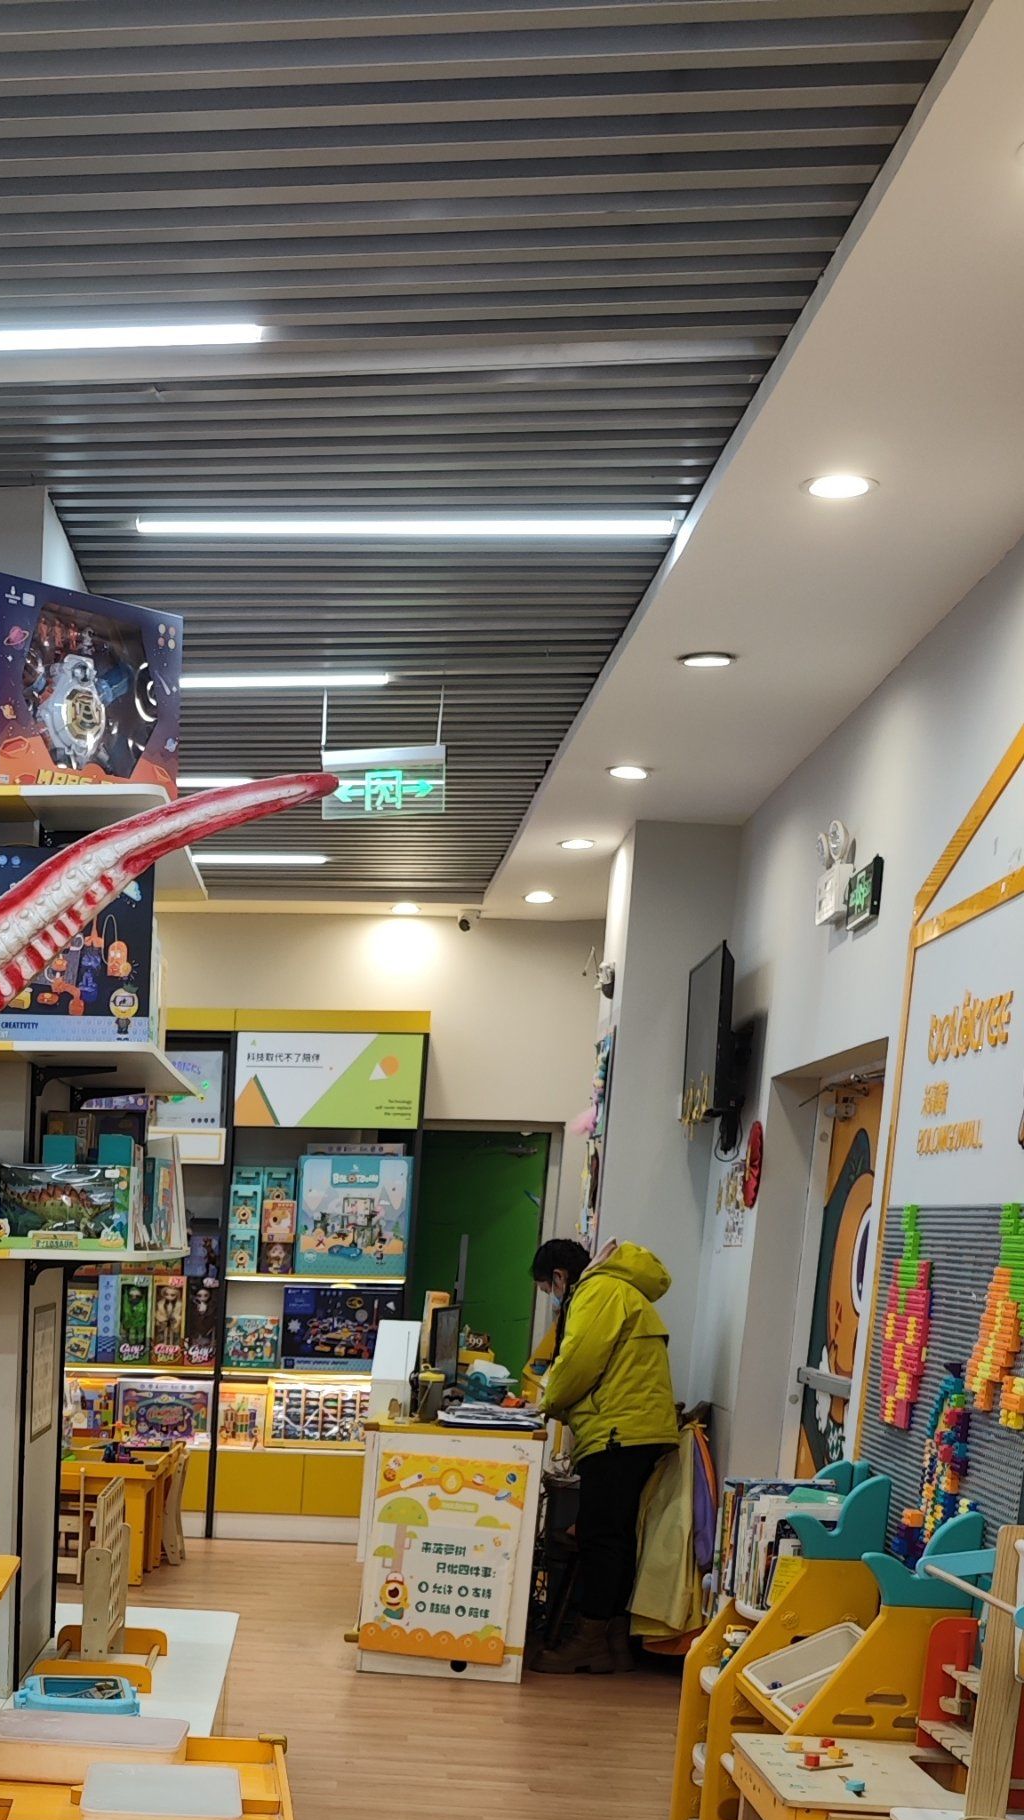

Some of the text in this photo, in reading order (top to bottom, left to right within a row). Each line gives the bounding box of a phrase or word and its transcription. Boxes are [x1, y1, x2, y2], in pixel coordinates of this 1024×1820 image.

[0, 1021, 39, 1029] CREATIVITY
[246, 1052, 321, 1063] 科技取代不了陪伴
[432, 1583, 493, 1600] 允许 支持
